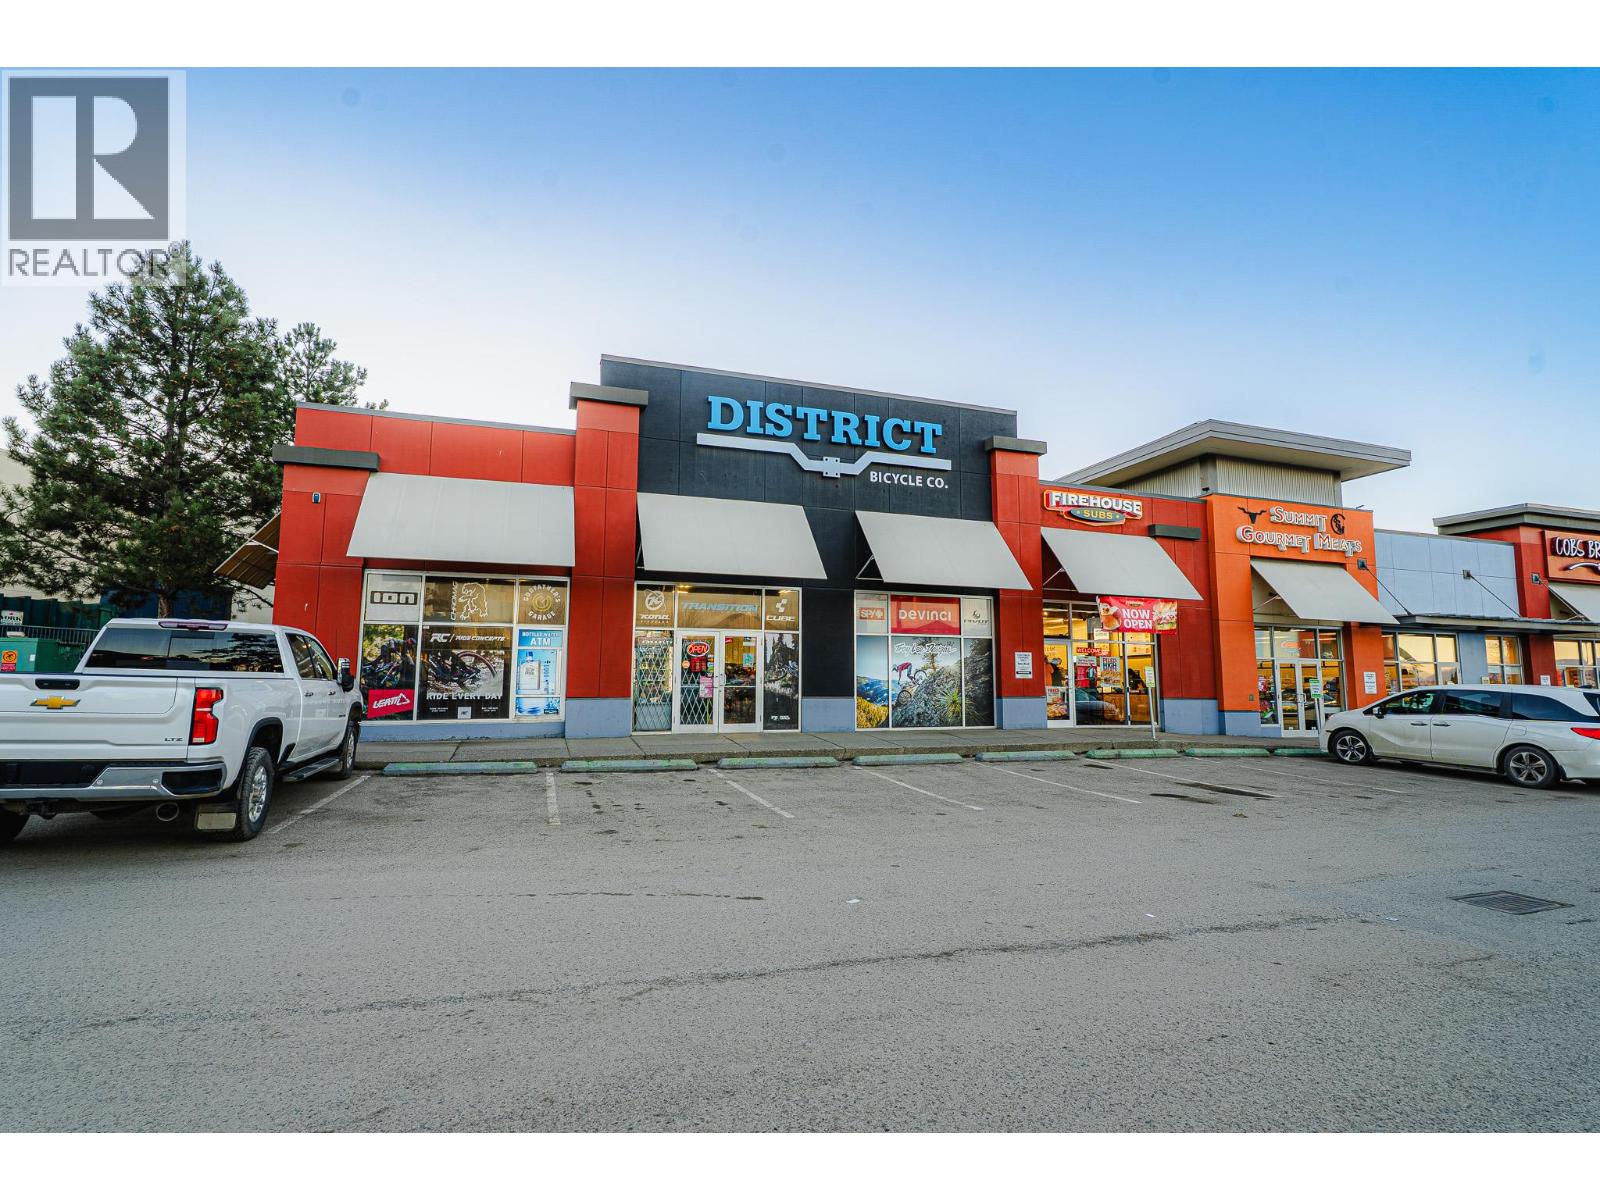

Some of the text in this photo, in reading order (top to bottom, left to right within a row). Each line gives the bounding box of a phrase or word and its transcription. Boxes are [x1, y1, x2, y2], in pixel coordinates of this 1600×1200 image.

[707, 395, 943, 454] DISTRICT
[870, 471, 949, 489] BICYCLE CO.
[1050, 491, 1142, 515] FIREHOUSE
[1083, 509, 1113, 519] SUBS
[1272, 506, 1327, 532] SUMMIT
[1238, 525, 1311, 554] GOURMET
[1555, 536, 1585, 557] COBS
[528, 610, 556, 621] GARAGE
[1122, 608, 1150, 619] NOW
[1123, 619, 1153, 629] OPEN
[530, 638, 551, 646] ATM
[689, 644, 707, 654] OPEN
[426, 692, 503, 700] RIDE EVERY DAY
